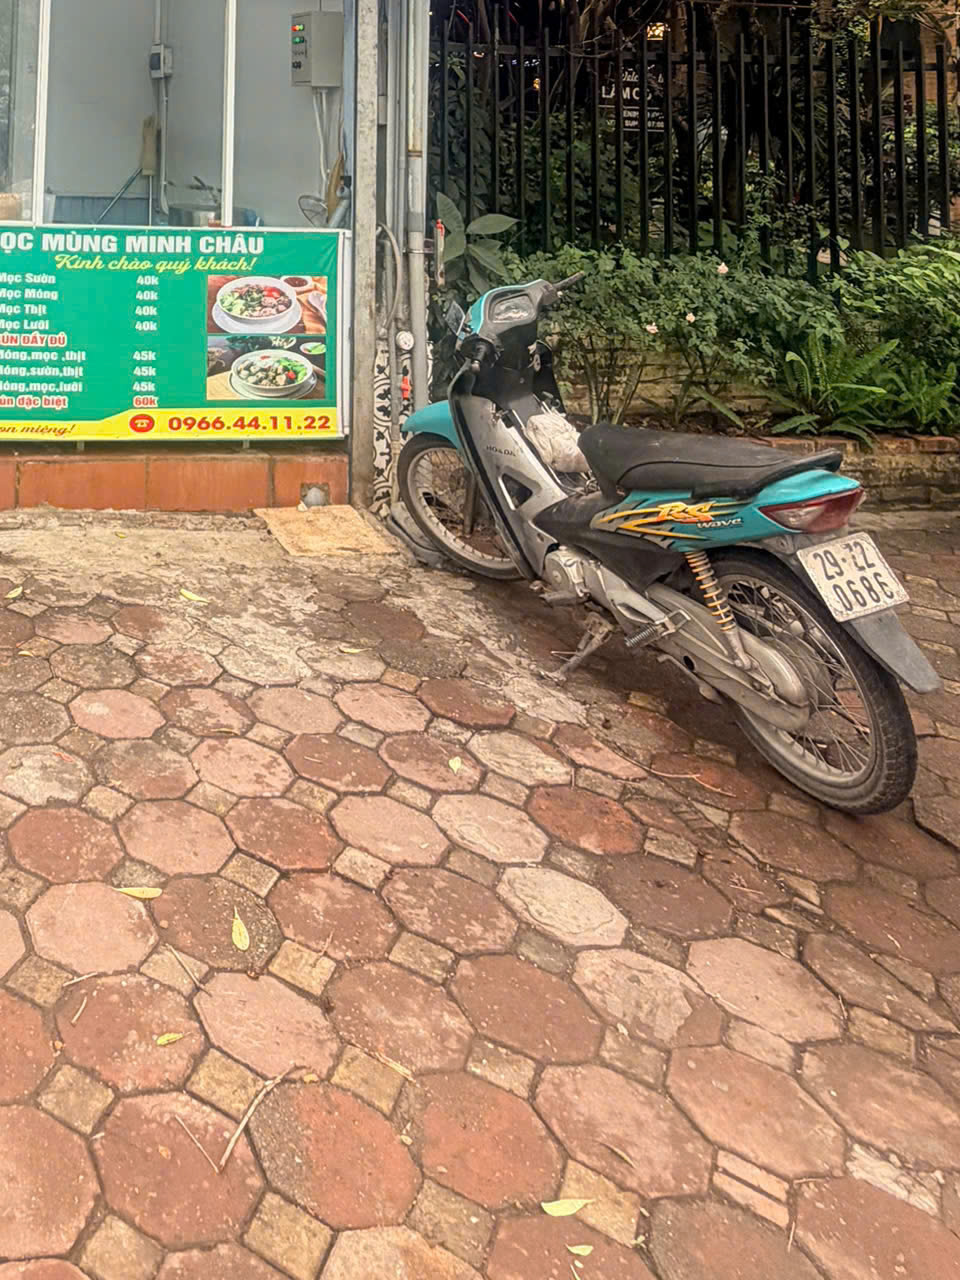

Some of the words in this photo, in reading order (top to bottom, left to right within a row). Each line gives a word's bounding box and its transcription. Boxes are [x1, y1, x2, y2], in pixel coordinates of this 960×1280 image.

[42, 230, 117, 252] MÙNG
[125, 235, 191, 253] MINH
[199, 233, 265, 253] CHÂU
[107, 255, 153, 270] chào
[155, 258, 191, 275] quý
[194, 257, 257, 270] khách!
[136, 275, 159, 285] 40k
[136, 291, 158, 301] 40k
[24, 305, 47, 317] Thịt
[135, 306, 157, 316] 40k
[135, 321, 157, 331] 40k
[133, 351, 156, 361] 45k
[133, 366, 156, 376] 45k
[133, 382, 155, 392] 45k
[133, 396, 158, 408] 60k
[168, 416, 330, 431] 0966.44.11.22
